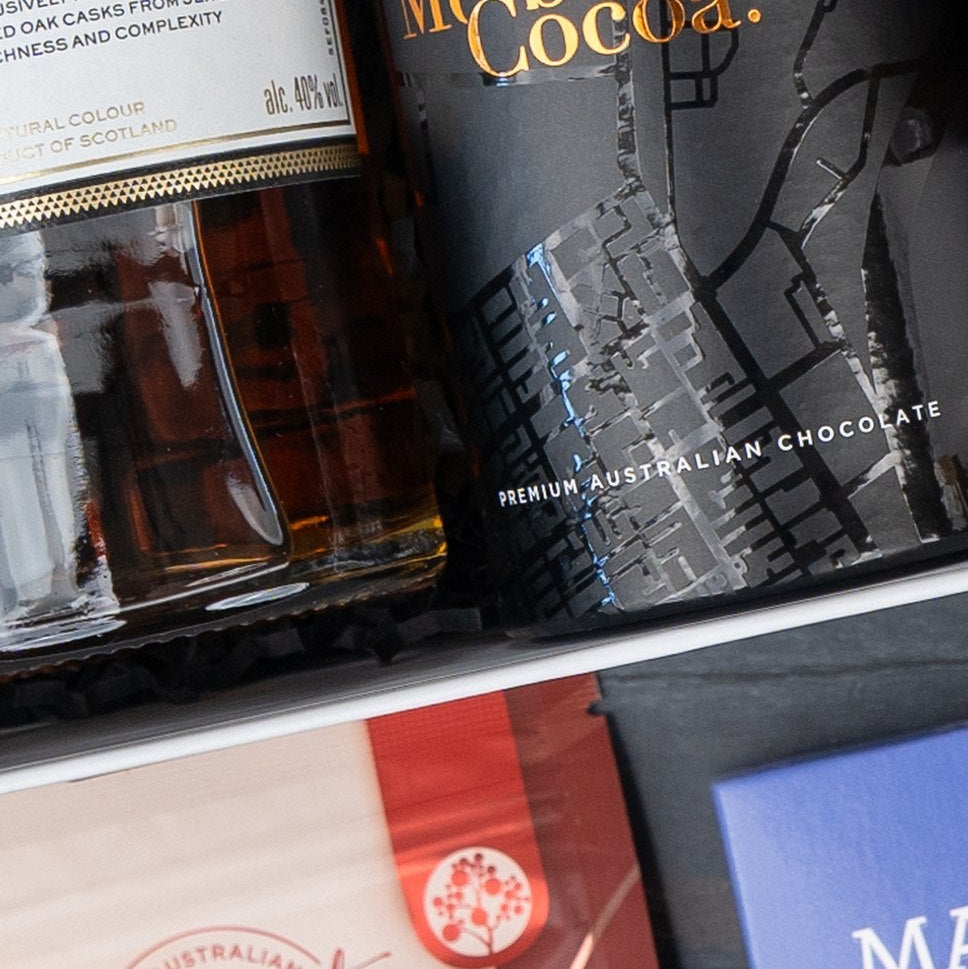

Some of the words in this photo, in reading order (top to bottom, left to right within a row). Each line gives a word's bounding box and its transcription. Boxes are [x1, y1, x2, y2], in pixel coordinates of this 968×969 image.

[20, 15, 59, 35] OAK
[62, 3, 125, 27] CASKS
[72, 29, 111, 50] AND
[115, 10, 223, 40] COMPLEXITY
[263, 79, 294, 116] alc.
[294, 74, 324, 111] 40%
[69, 101, 145, 127] COLOUR
[50, 137, 74, 153] OF
[79, 119, 178, 148] SCOTLAND
[499, 478, 578, 508] PREMIUM
[590, 441, 763, 492] AUSTRALIAN
[778, 400, 942, 452] CHOCOLATE
[153, 943, 303, 969] USTRALIAN
